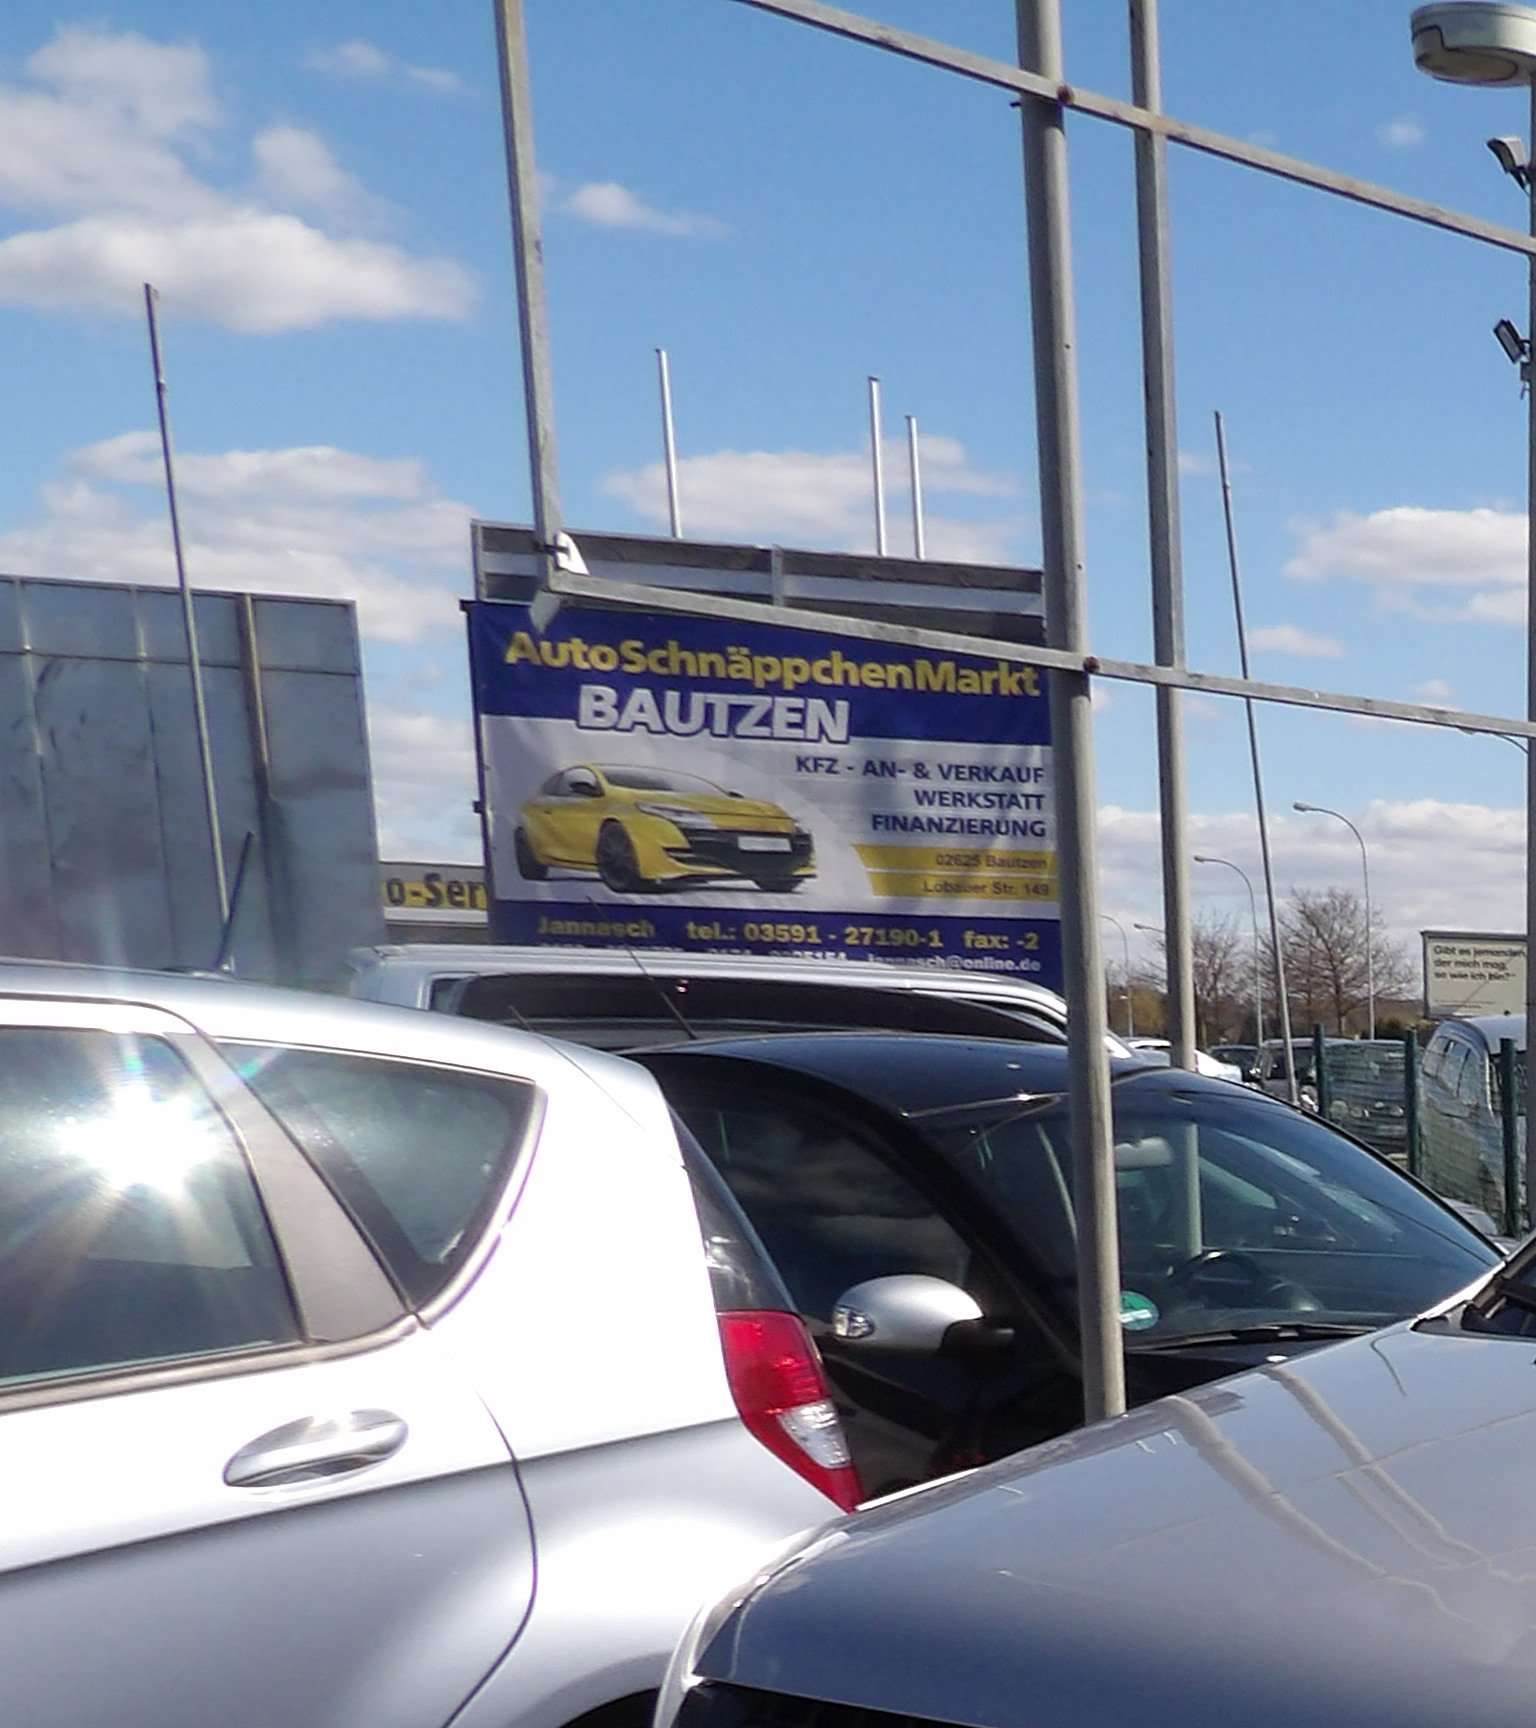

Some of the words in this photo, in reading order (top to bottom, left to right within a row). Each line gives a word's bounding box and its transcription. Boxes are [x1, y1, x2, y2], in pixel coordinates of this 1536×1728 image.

[504, 631, 1041, 697] AutoSchnäppchenMarkt
[577, 684, 850, 744] BAUTZEN
[796, 756, 840, 775] KFZ
[913, 762, 930, 779] &
[938, 763, 1045, 784] VERKAUF
[914, 789, 1046, 811] WERKSTATT
[871, 814, 1046, 837] FINANZIERUNG
[986, 853, 1047, 868] Bautzen
[742, 922, 822, 944] 03591
[844, 926, 944, 948] 27190-1
[1017, 932, 1039, 949] -2
